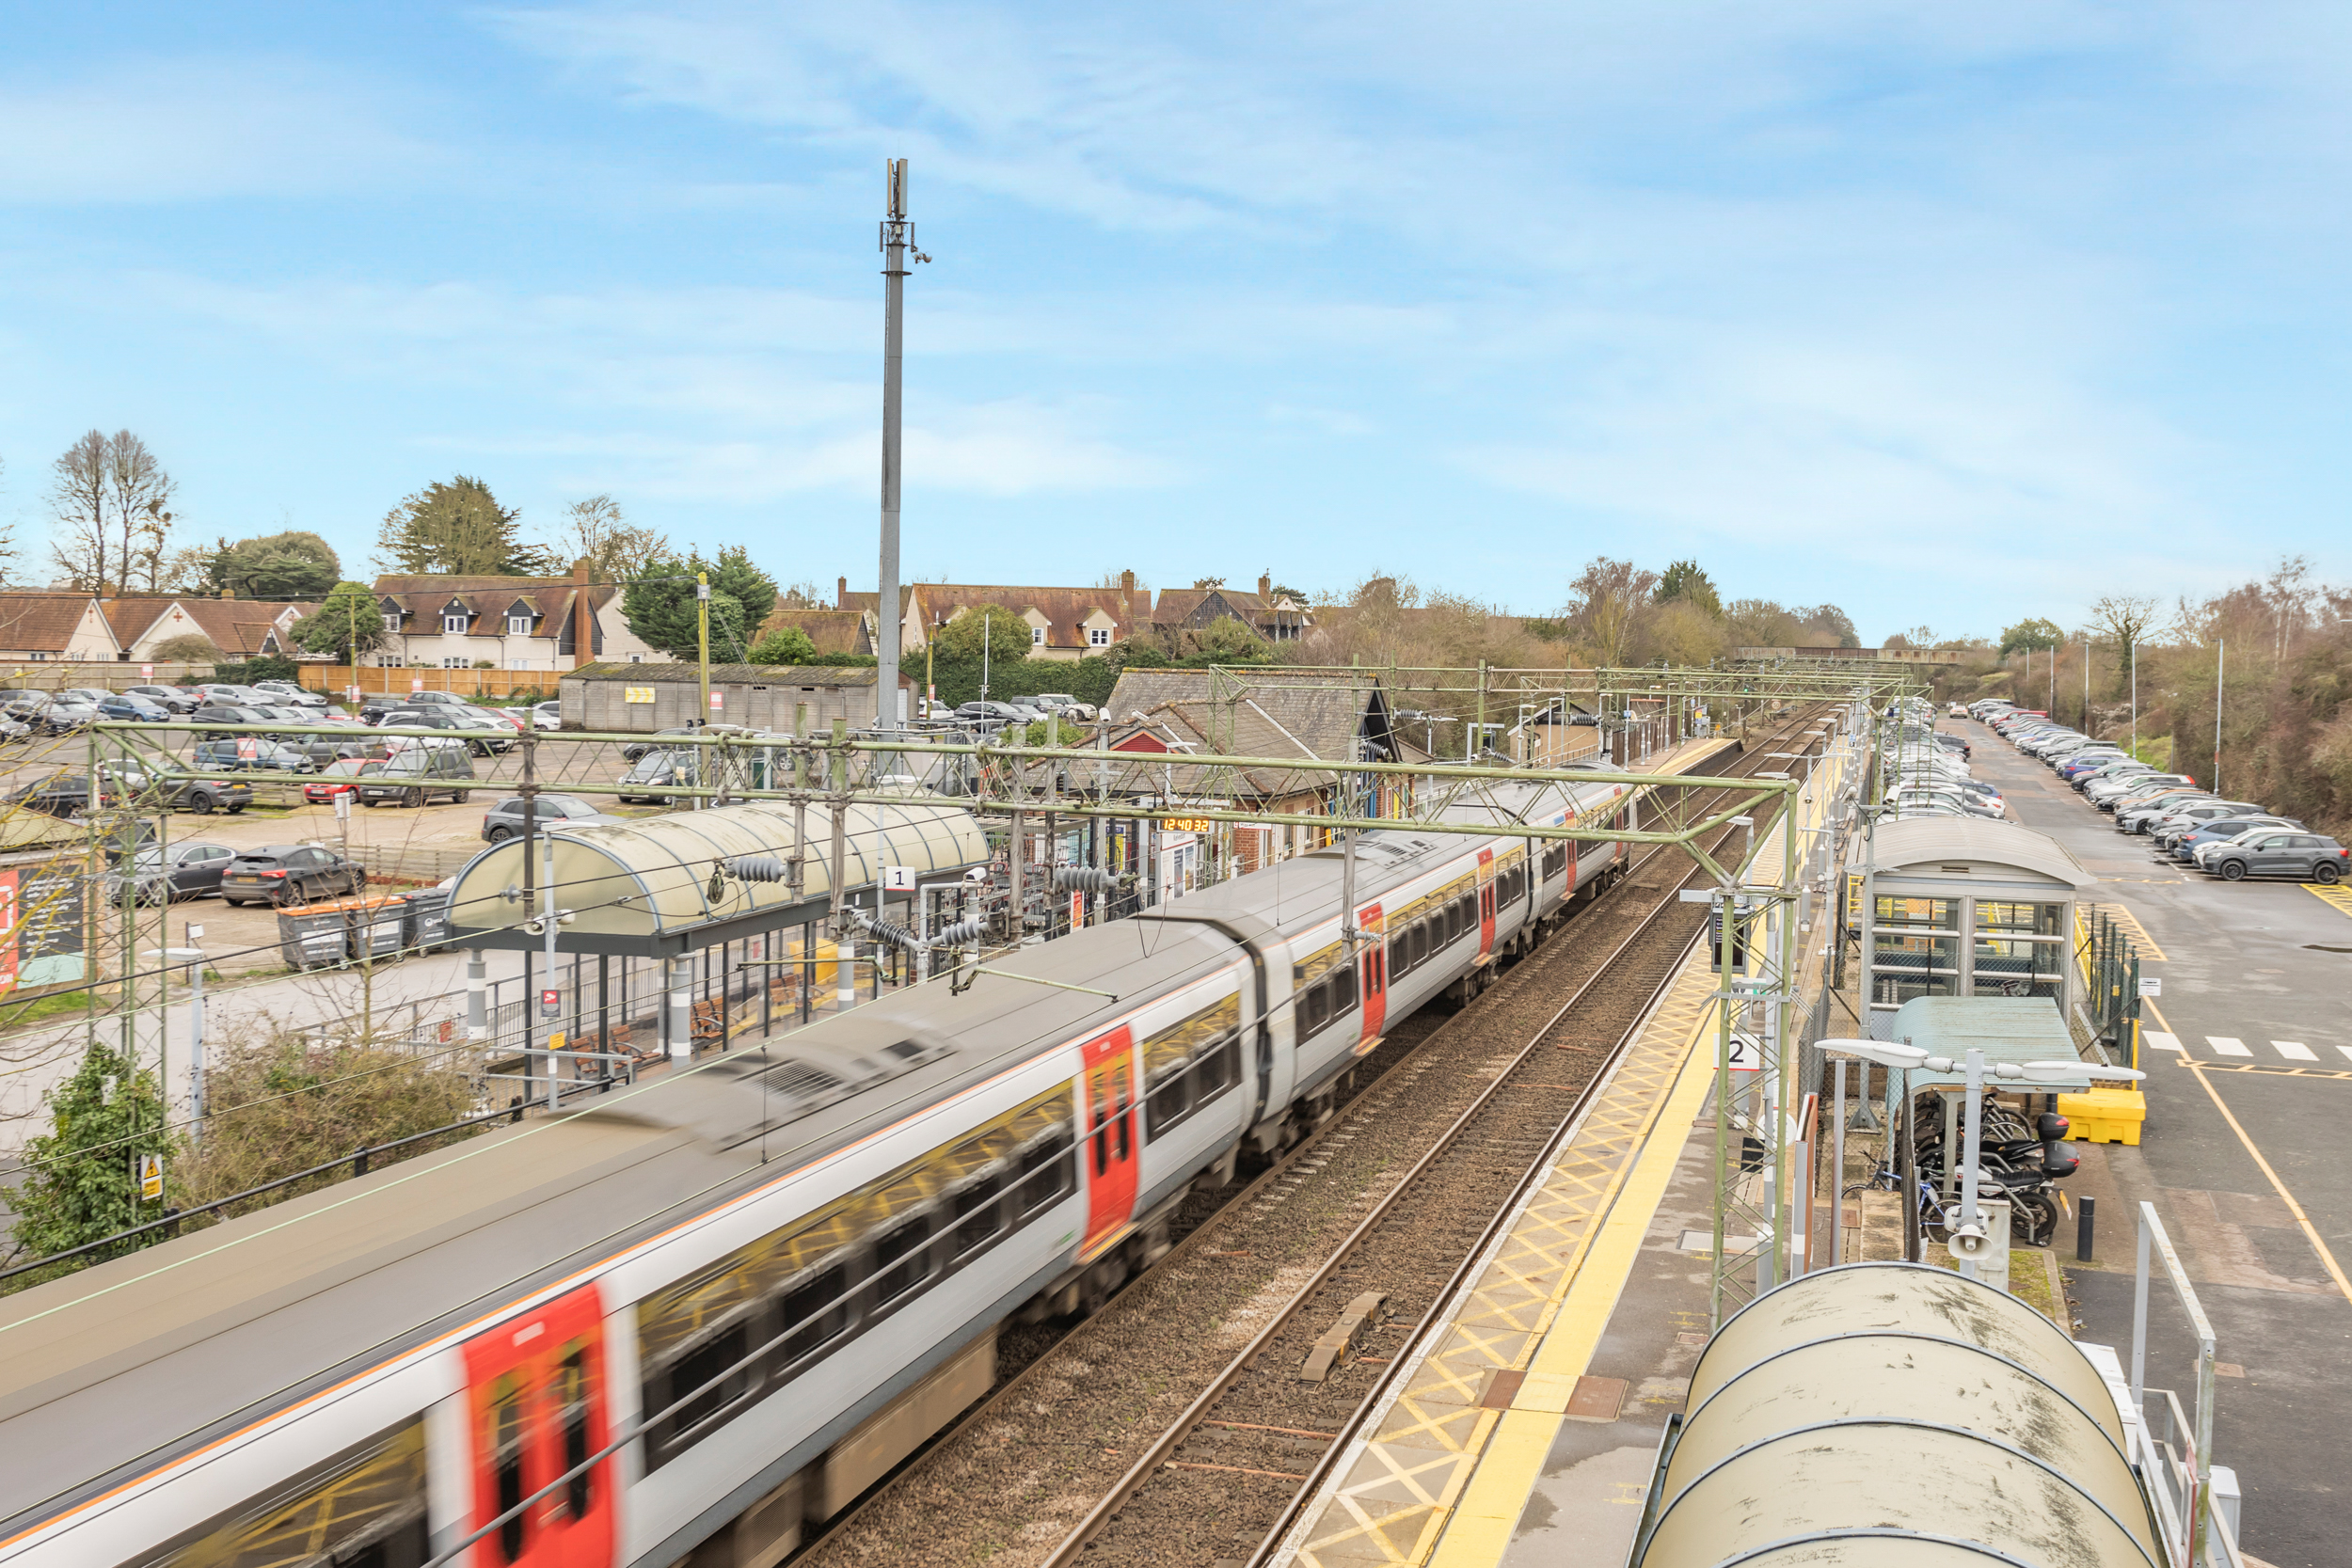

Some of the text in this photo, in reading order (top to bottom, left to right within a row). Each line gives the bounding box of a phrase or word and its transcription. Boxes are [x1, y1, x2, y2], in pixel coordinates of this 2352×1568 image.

[1164, 818, 1209, 832] 12 40 32
[896, 871, 904, 885] 1
[1729, 1039, 1743, 1063] 2
